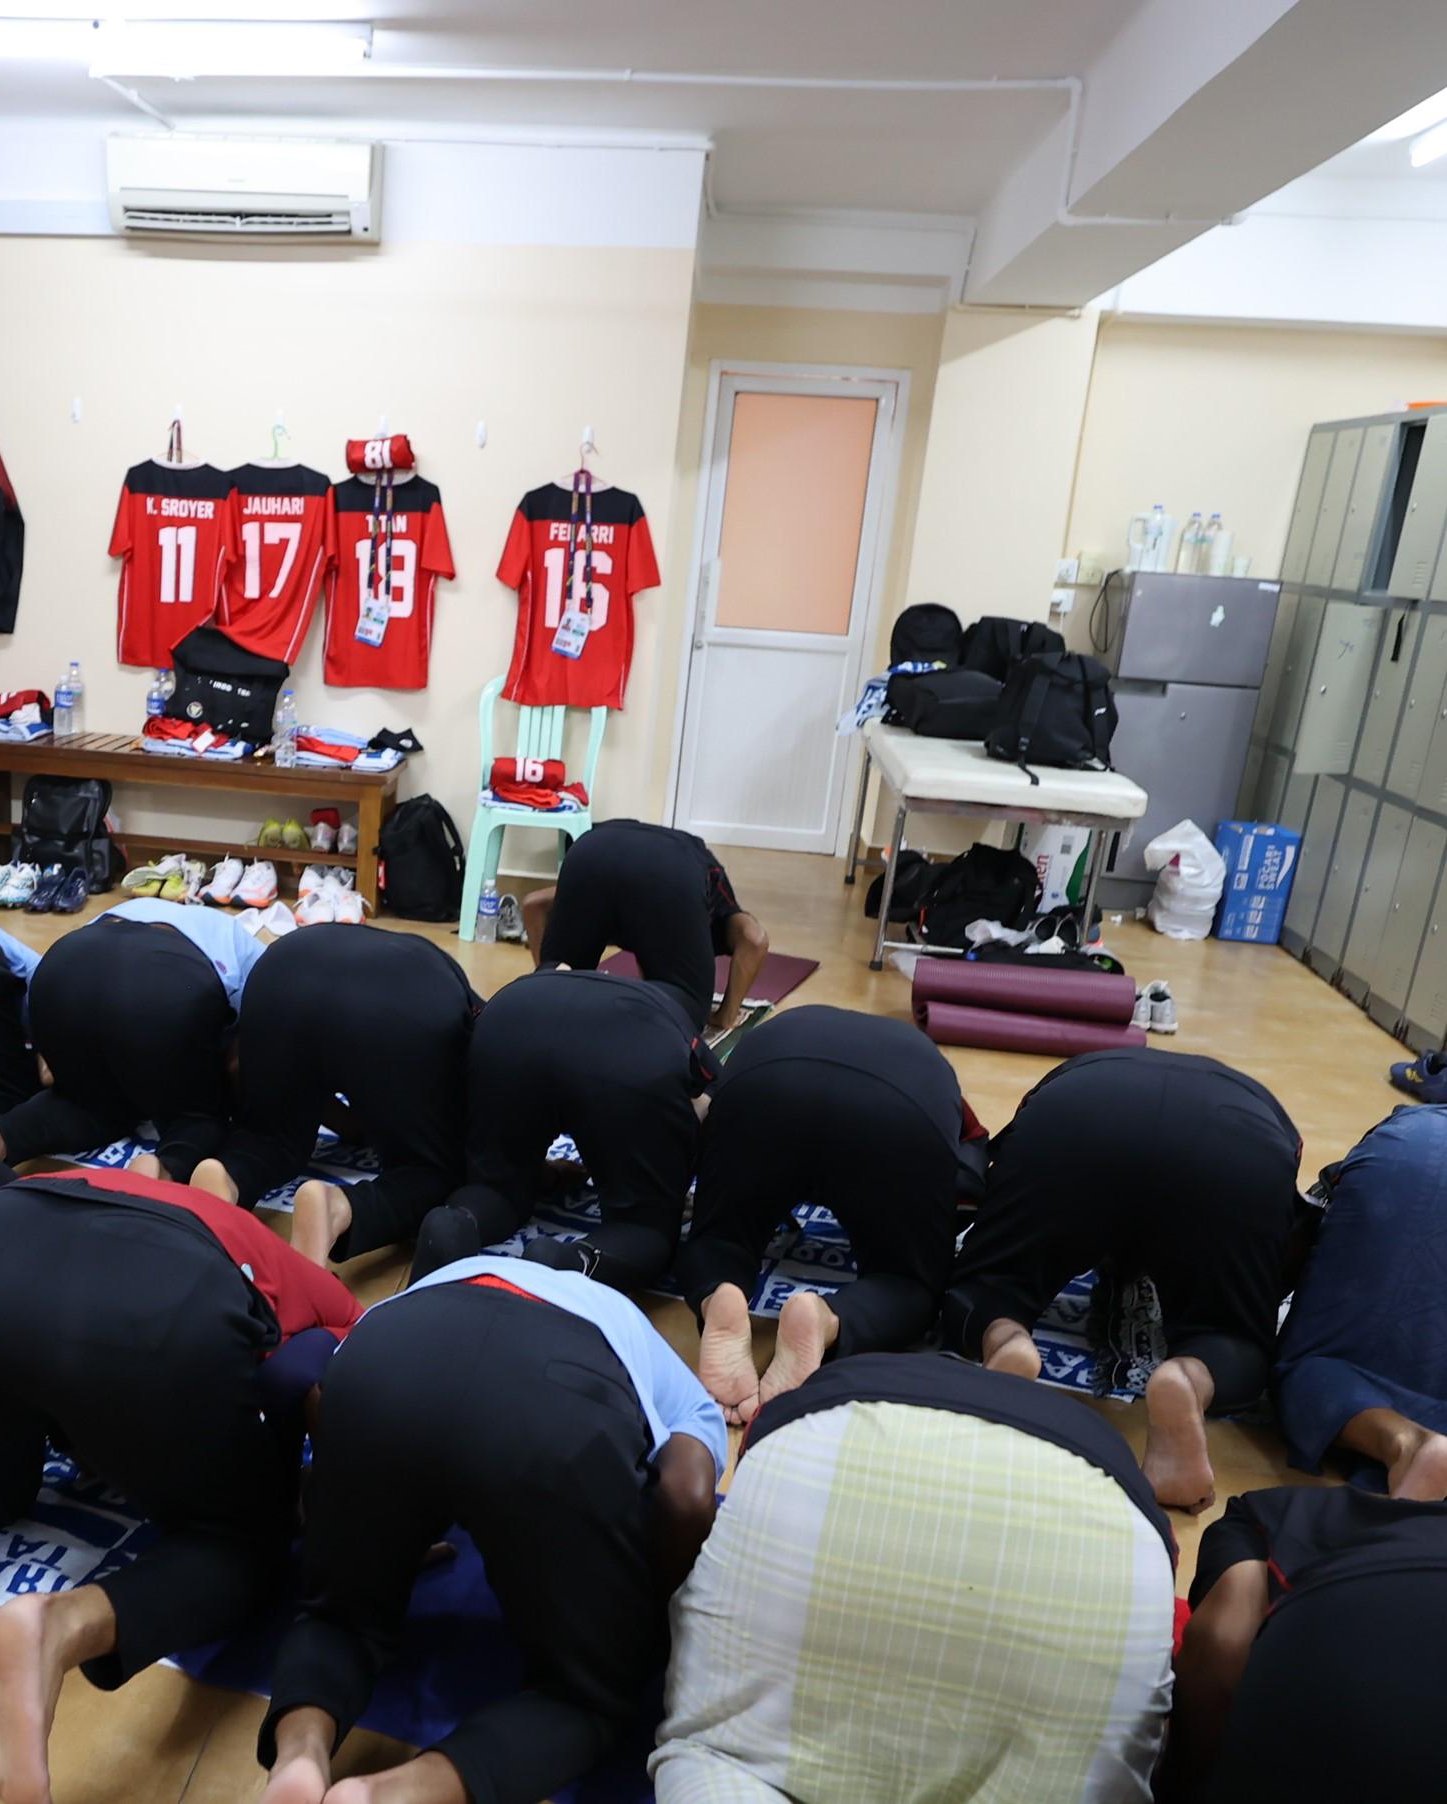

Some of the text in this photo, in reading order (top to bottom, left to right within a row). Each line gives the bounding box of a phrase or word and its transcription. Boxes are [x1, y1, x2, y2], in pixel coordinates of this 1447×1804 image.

[160, 498, 214, 519] SROYER
[243, 496, 304, 515] JAUHARI
[365, 514, 407, 533] TTAN
[549, 522, 614, 544] FEARRI
[158, 526, 197, 603] 11
[242, 521, 302, 599] 17
[544, 547, 613, 631] 16
[515, 757, 544, 783] 16
